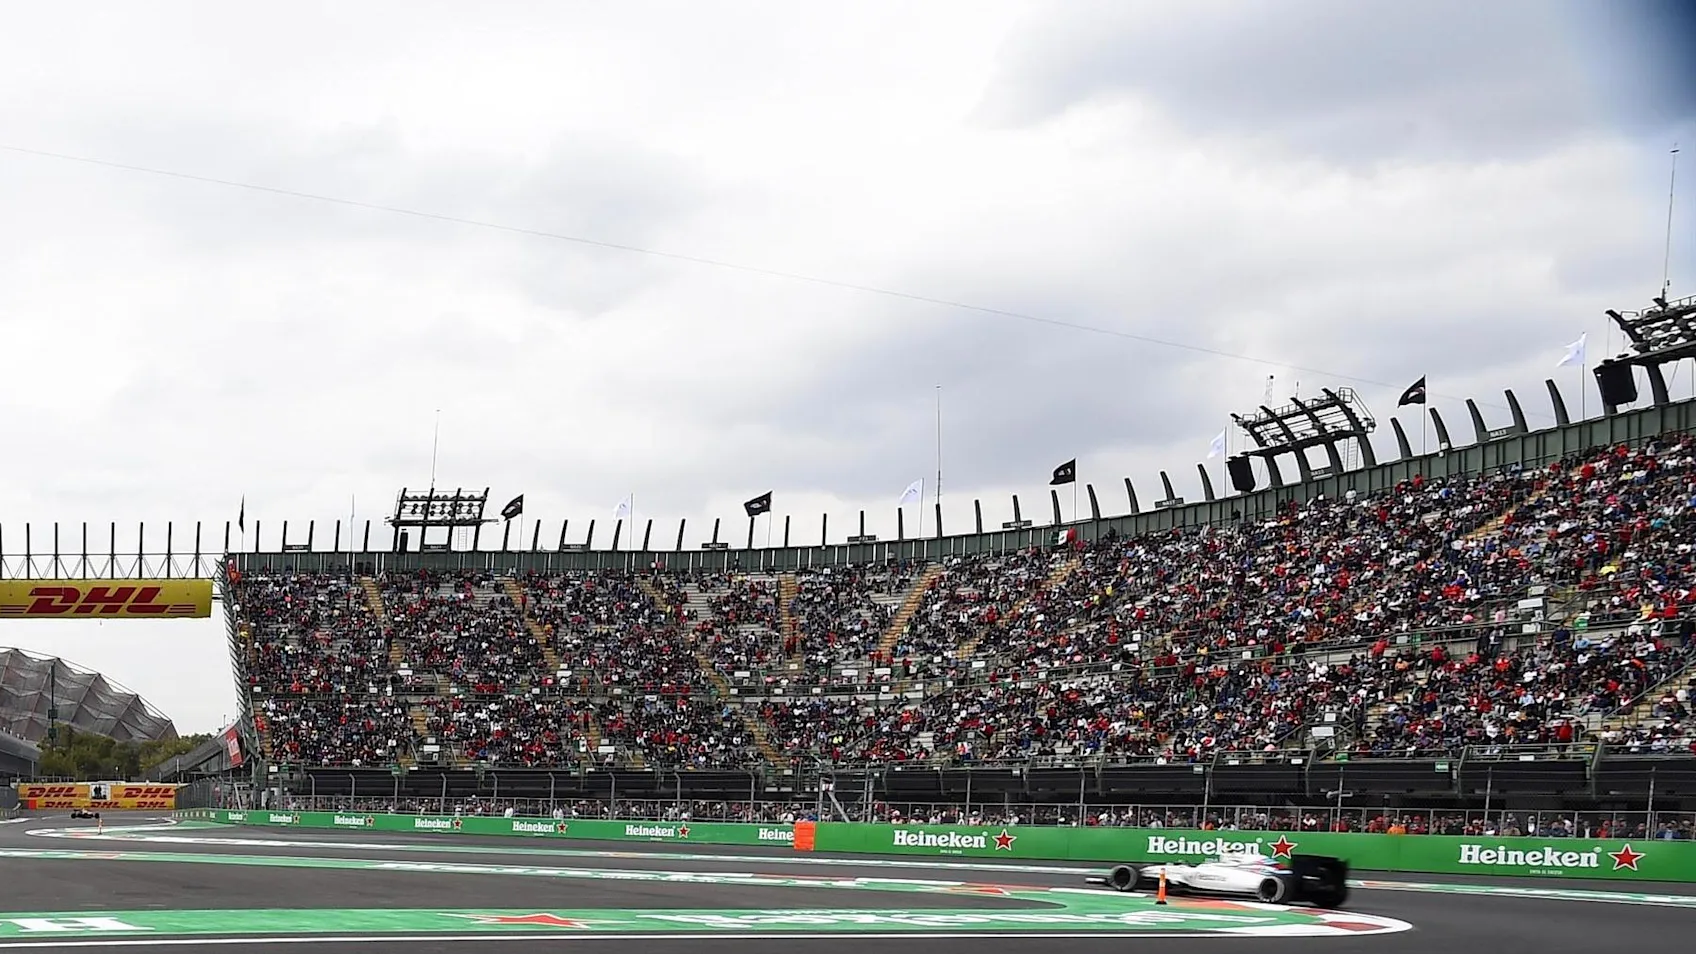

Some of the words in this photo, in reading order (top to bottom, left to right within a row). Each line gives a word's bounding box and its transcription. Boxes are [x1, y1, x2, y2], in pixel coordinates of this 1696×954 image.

[26, 587, 170, 614] DHL
[28, 787, 78, 798] DHL
[124, 787, 174, 798] DHL
[414, 817, 452, 829] Heineken
[512, 820, 556, 833] Heineken
[625, 824, 676, 838] Heineken
[758, 827, 794, 841] Heine
[893, 829, 987, 849] Heineken
[1147, 836, 1261, 856] Heineken
[1458, 843, 1600, 868] Heineken
